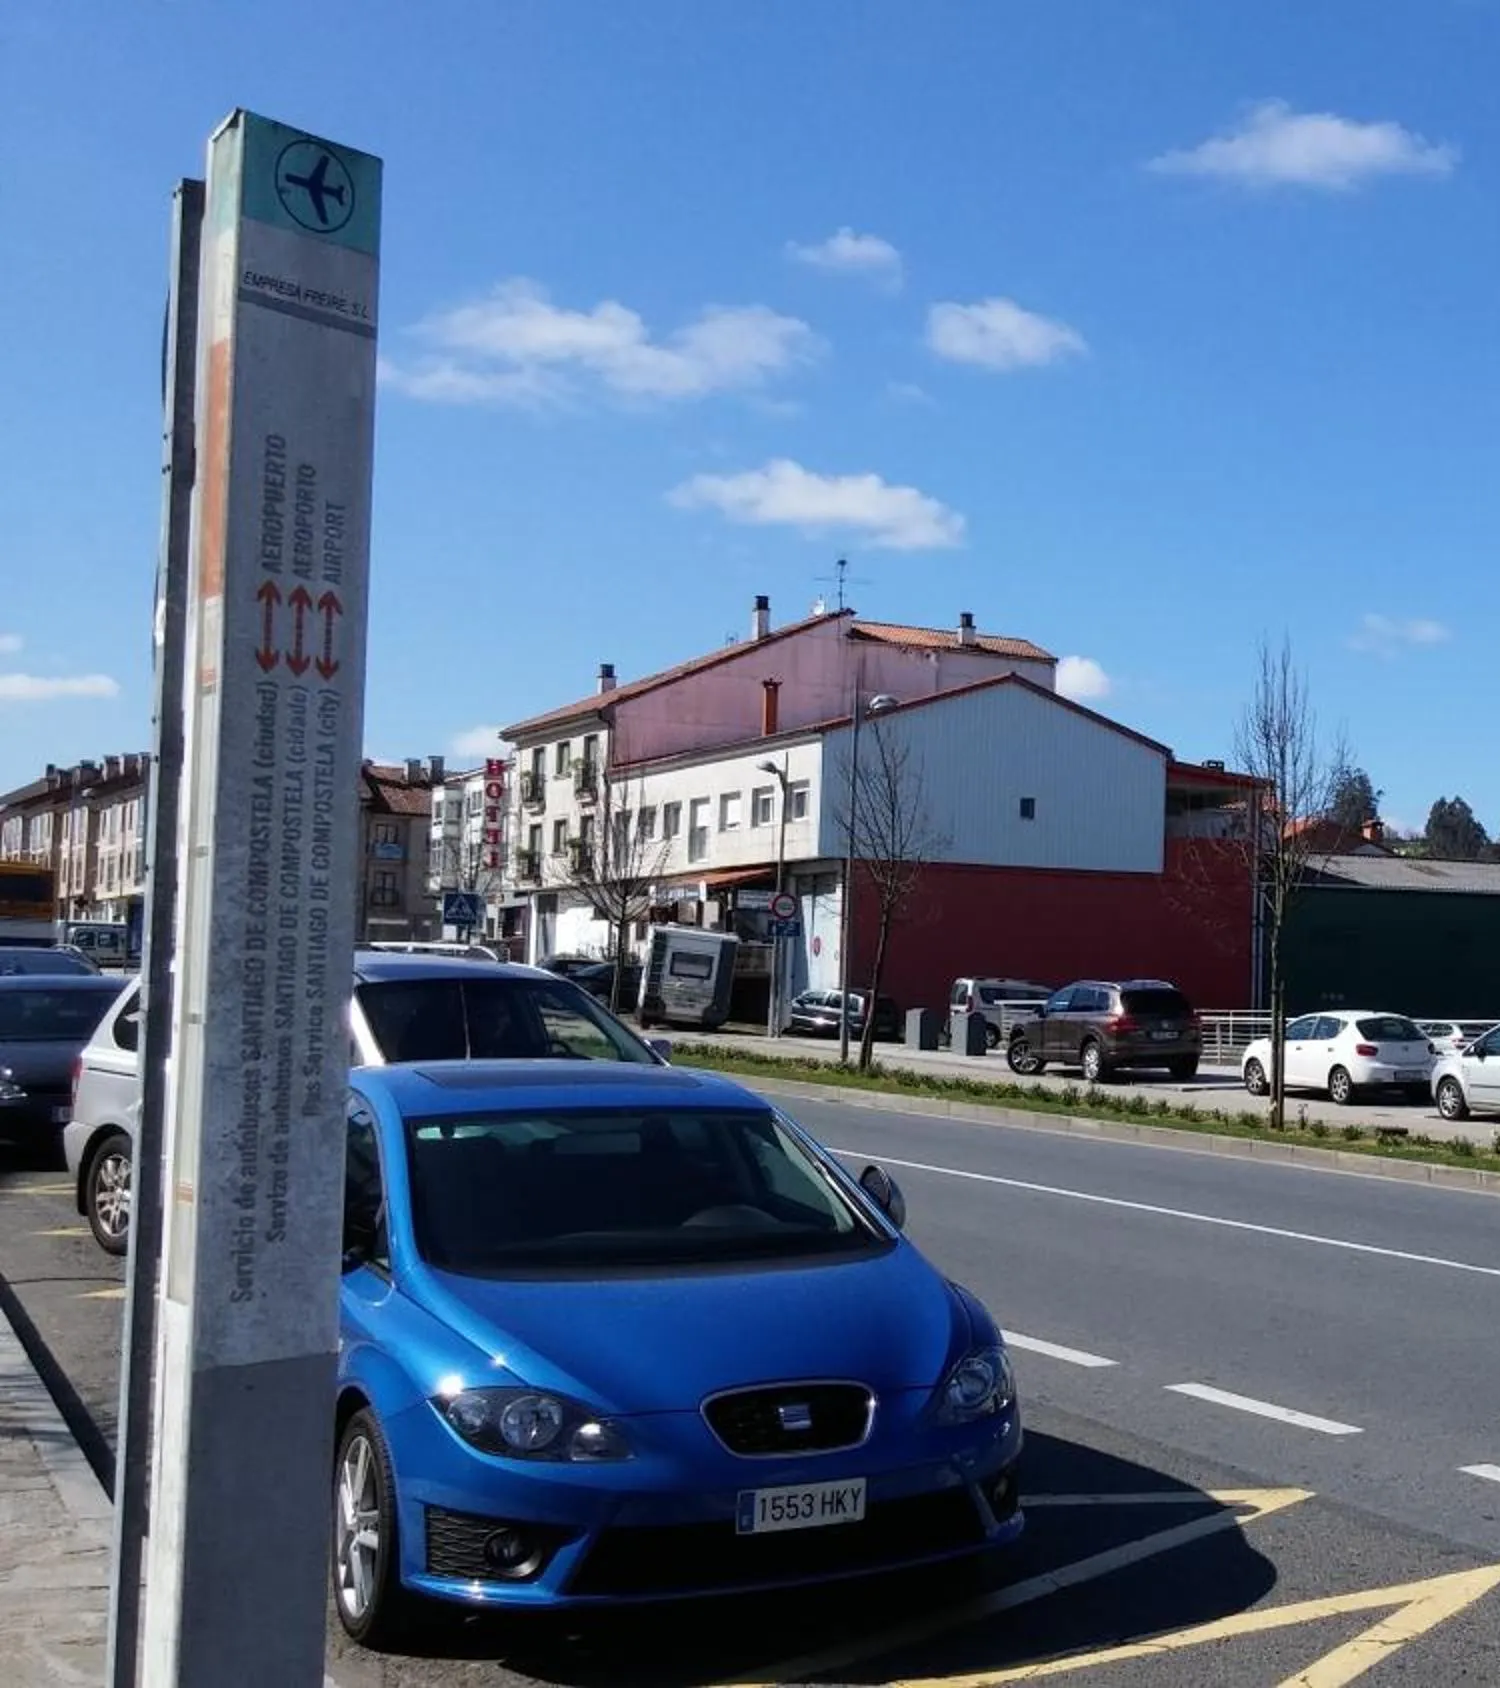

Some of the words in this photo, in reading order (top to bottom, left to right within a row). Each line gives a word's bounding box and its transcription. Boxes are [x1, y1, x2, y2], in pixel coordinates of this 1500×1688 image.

[243, 270, 302, 301] EMPRESA
[263, 433, 287, 574] AEROPUERTO
[294, 464, 317, 581] AEROPORTO
[324, 499, 347, 586] AIRPORT
[253, 681, 280, 768] (ciudad)
[318, 688, 343, 737] (city)
[250, 775, 275, 917] COMPOSTELA
[281, 770, 306, 899] COMPOSTELA
[312, 744, 338, 871] COMPOSTELA
[281, 904, 301, 929] DE
[312, 876, 332, 901] DE
[249, 918, 268, 951] DE
[307, 907, 331, 1000] SANTIAGO
[241, 958, 267, 1062] SANTIAGO
[276, 936, 300, 1030] SANTIAGO
[305, 1006, 327, 1077] Service
[238, 1069, 264, 1177] autobuses
[272, 1036, 295, 1135] autobuses
[269, 1140, 291, 1164] de
[237, 1183, 259, 1210] de
[267, 1170, 290, 1243] Servizo
[232, 1216, 257, 1302] Servicio
[761, 1493, 815, 1522] 1553
[821, 1487, 861, 1517] HKY
